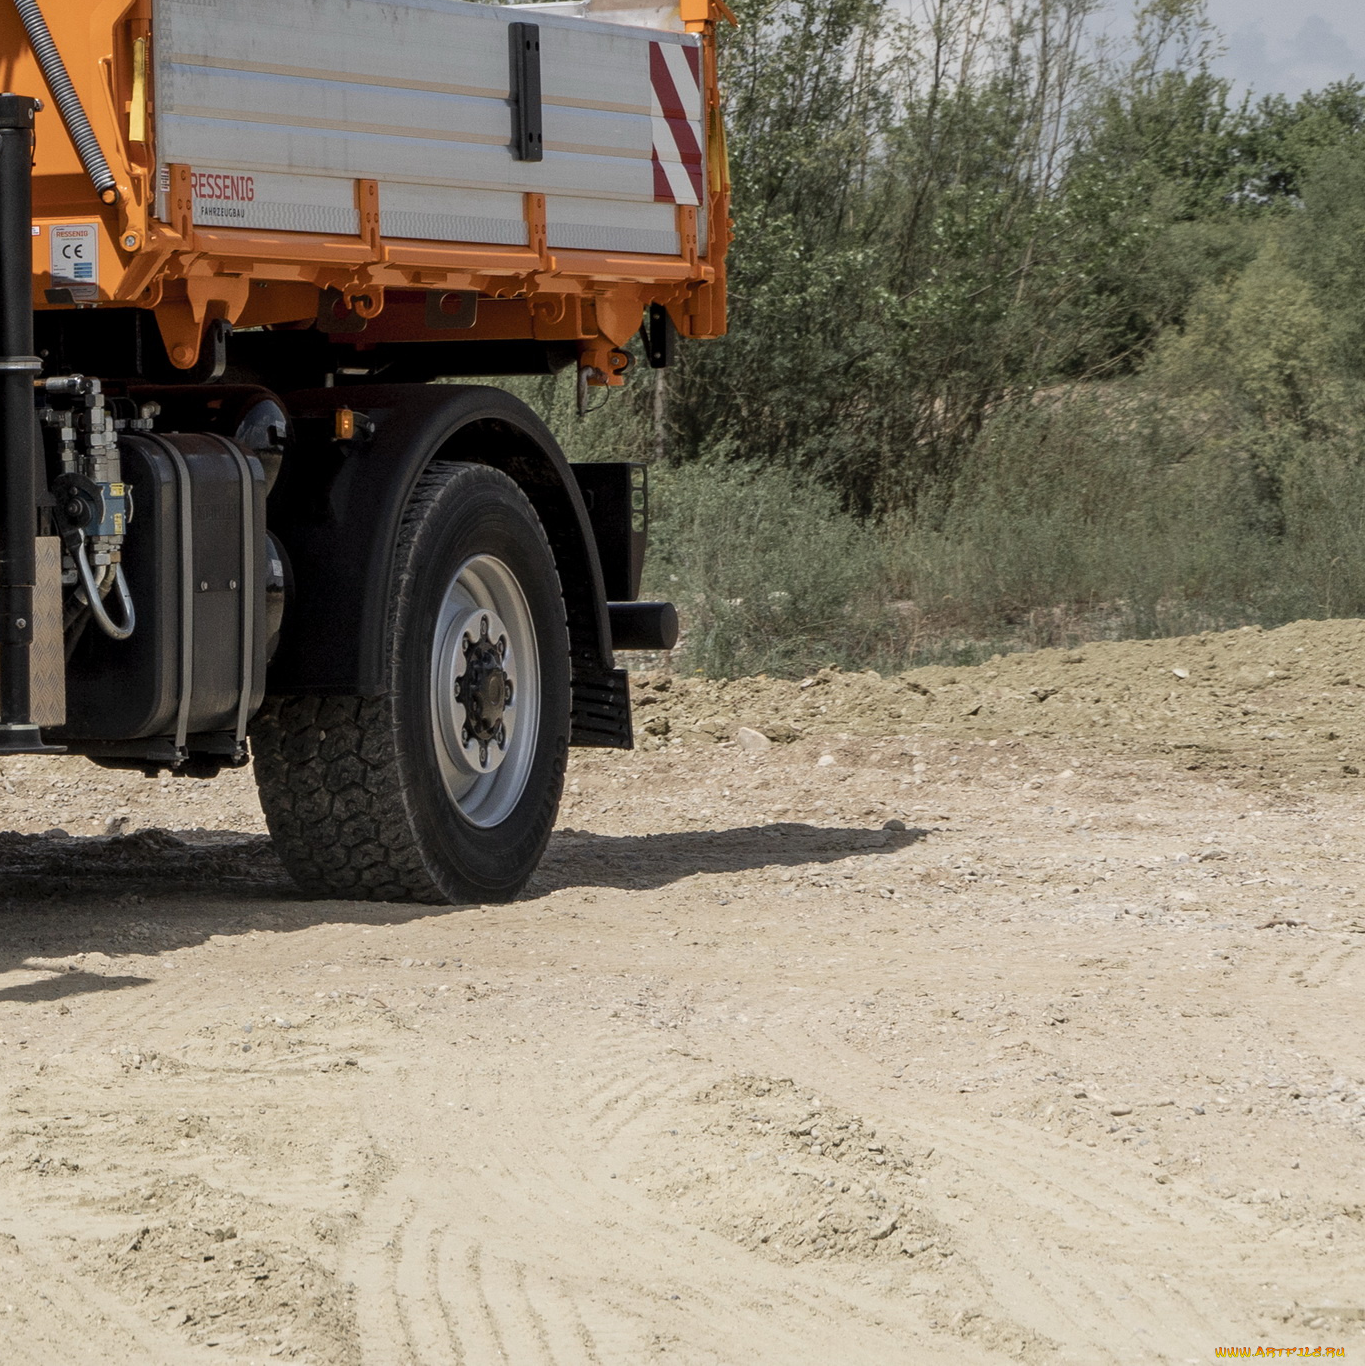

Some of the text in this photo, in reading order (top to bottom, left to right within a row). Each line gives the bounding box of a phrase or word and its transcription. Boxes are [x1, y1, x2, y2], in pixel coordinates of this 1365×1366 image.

[190, 172, 255, 202] RESSENIG
[200, 206, 246, 218] FAHRZEUGBAU
[55, 230, 89, 238] RESSENIG
